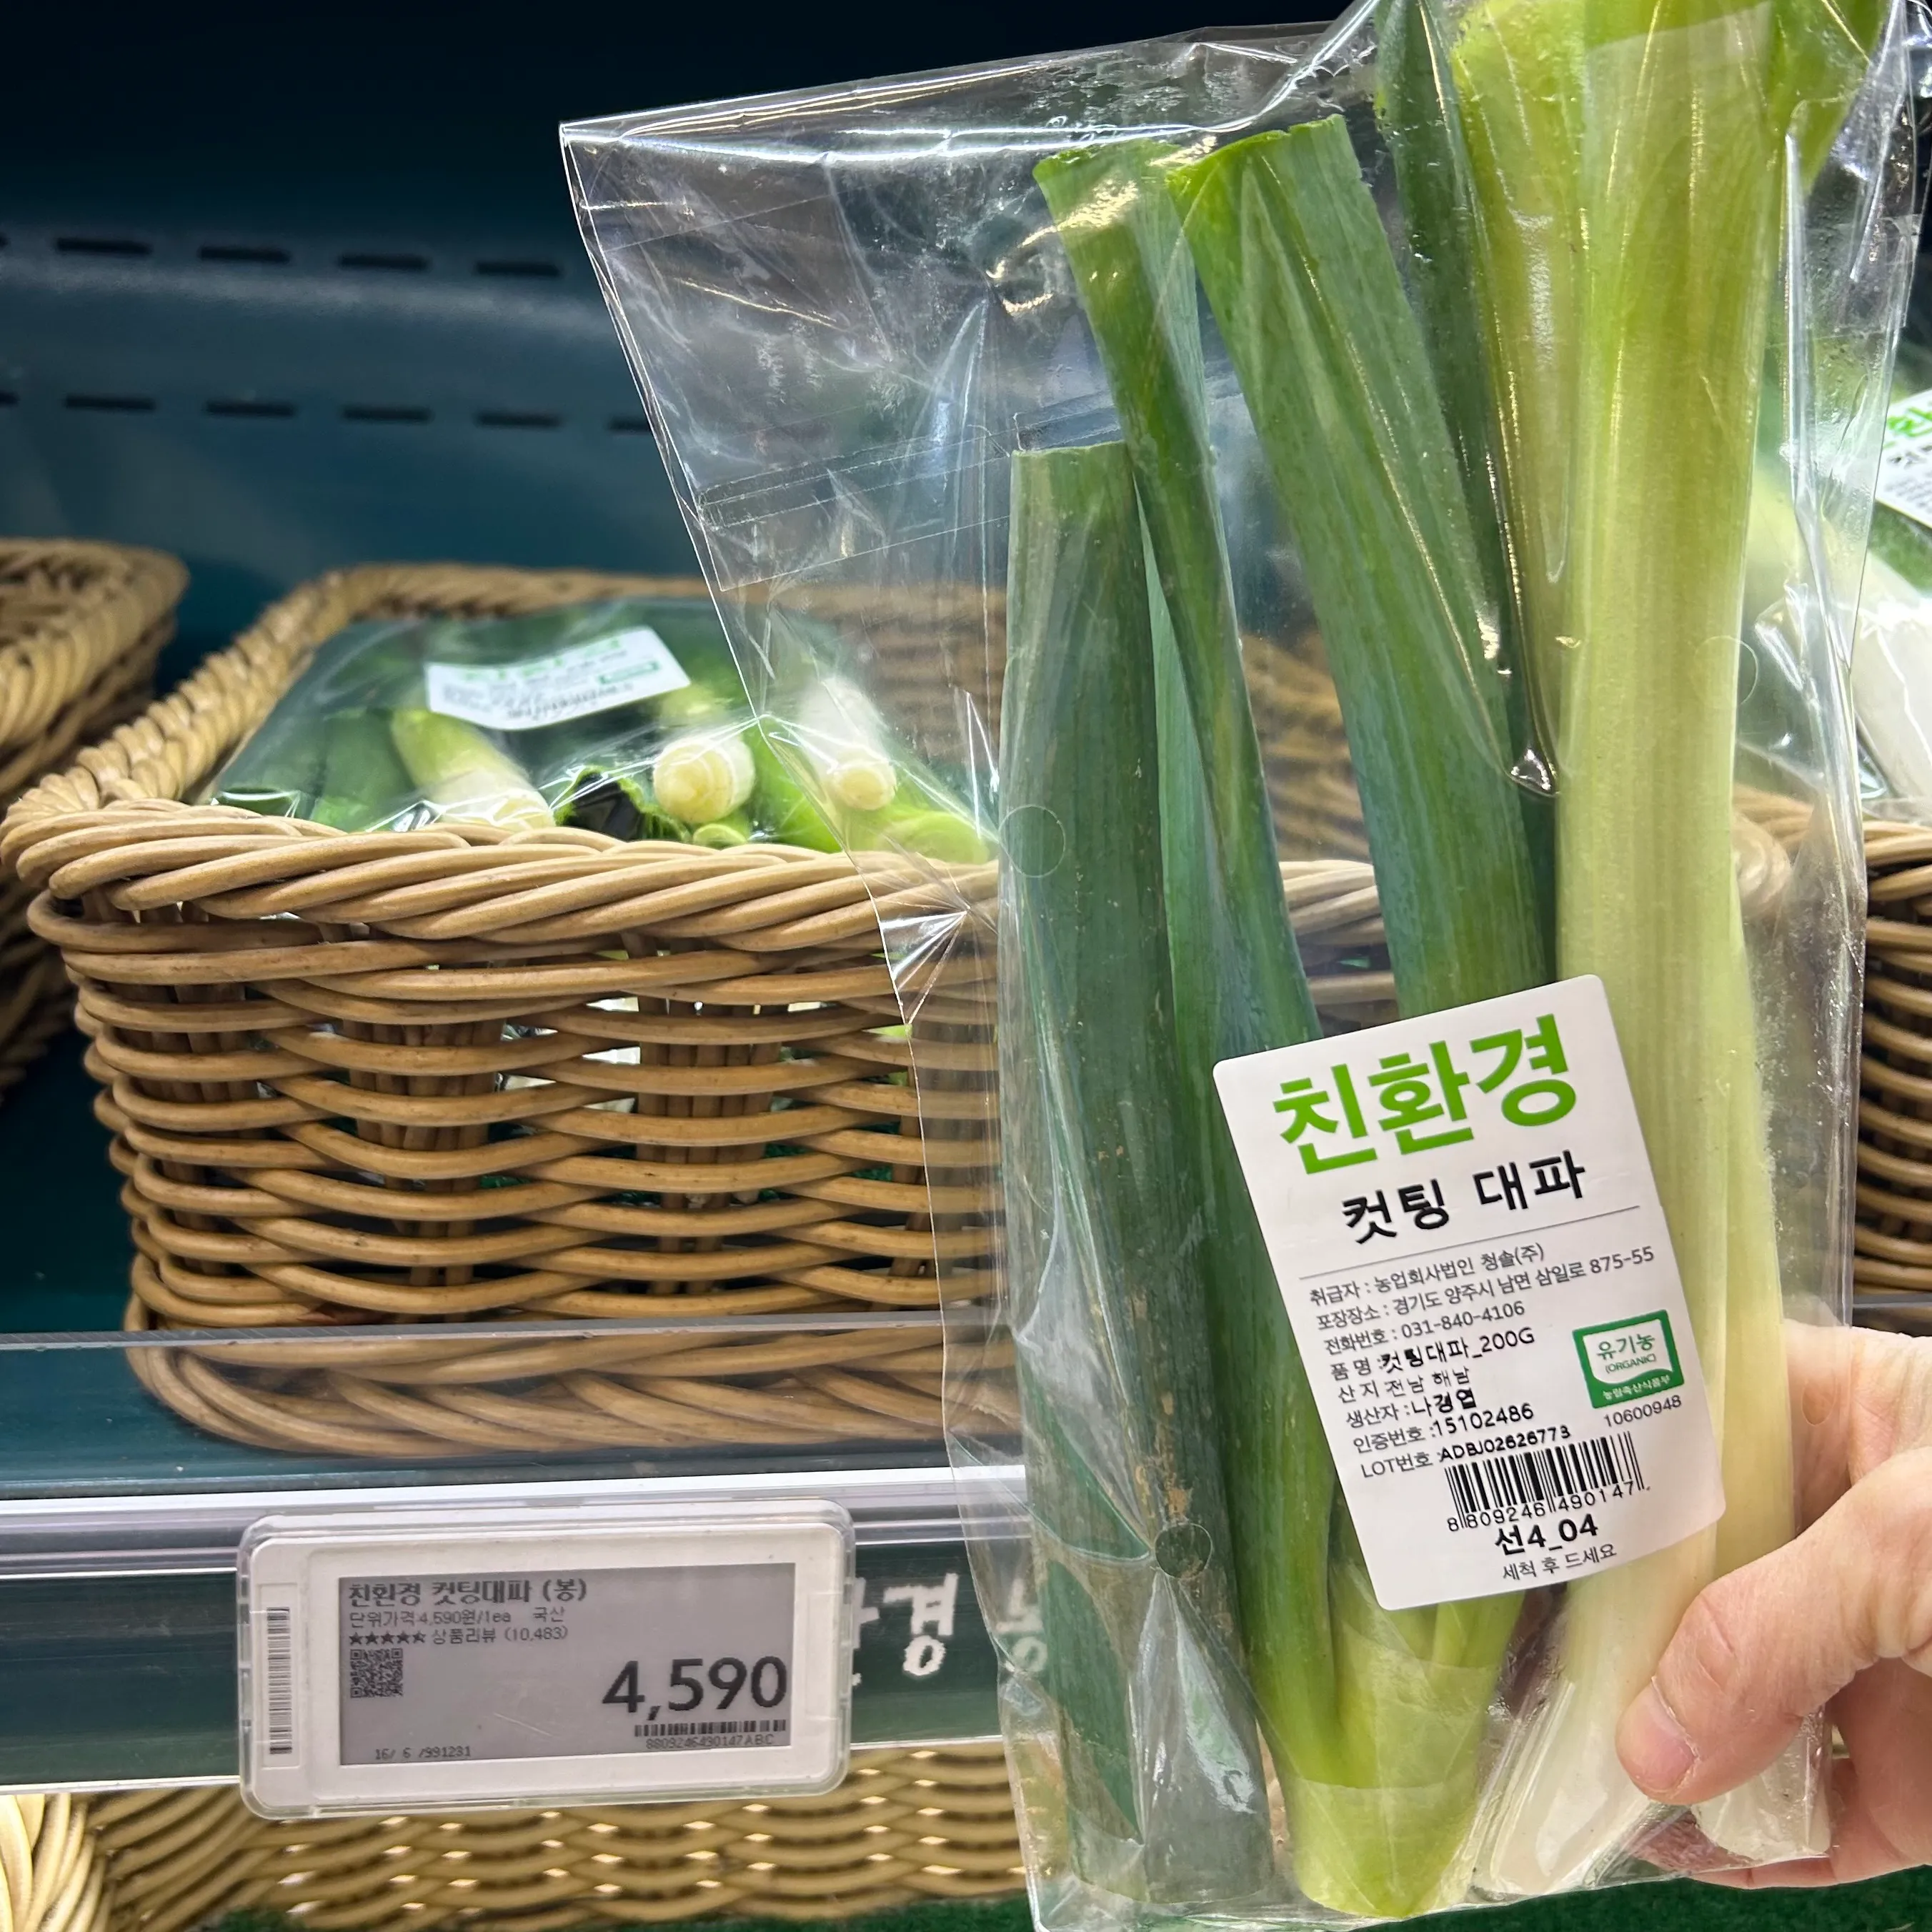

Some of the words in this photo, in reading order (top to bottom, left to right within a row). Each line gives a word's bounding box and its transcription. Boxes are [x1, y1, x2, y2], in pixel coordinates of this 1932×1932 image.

[1272, 1013, 1577, 1175] 친환경
[1342, 1178, 1449, 1245] 컷팅
[1473, 1149, 1586, 1210] 대파
[1309, 1280, 1360, 1307] 취급자
[1373, 1258, 1475, 1293] 농업회사법인
[1480, 1242, 1545, 1271] 청솔(주)
[1316, 1305, 1381, 1330] 포장장소
[1393, 1290, 1443, 1315] 경기도
[1444, 1279, 1495, 1305] 양주시
[1497, 1271, 1532, 1295] 남면
[1535, 1261, 1587, 1287] 삼일로
[1589, 1245, 1655, 1273] 875-55
[1323, 1328, 1389, 1355] 전화번호
[1401, 1300, 1525, 1338] 031-840-4106
[1596, 1333, 1656, 1360] 유기농
[1605, 1353, 1658, 1375] (ORGANIC)
[1384, 1375, 1424, 1398] 전남
[1431, 1365, 1470, 1387] 해남
[1345, 1403, 1399, 1428] 생산자
[1603, 1394, 1683, 1428] 10600948
[1353, 1426, 1426, 1454] 인증번호
[1360, 1451, 1433, 1478] LOT번호
[1495, 1513, 1599, 1556] 선4_04
[1502, 1559, 1537, 1580] 세척
[1541, 1556, 1560, 1575] 후
[1565, 1543, 1618, 1569] 드세요
[349, 1583, 422, 1607] 친환경
[432, 1579, 532, 1606] 컷팅대파
[542, 1578, 587, 1602] (봉)
[532, 1605, 565, 1623] 국산
[432, 1628, 497, 1645] 상품리뷰
[504, 1625, 569, 1642] (10,483)
[602, 1655, 787, 1721] 4,590
